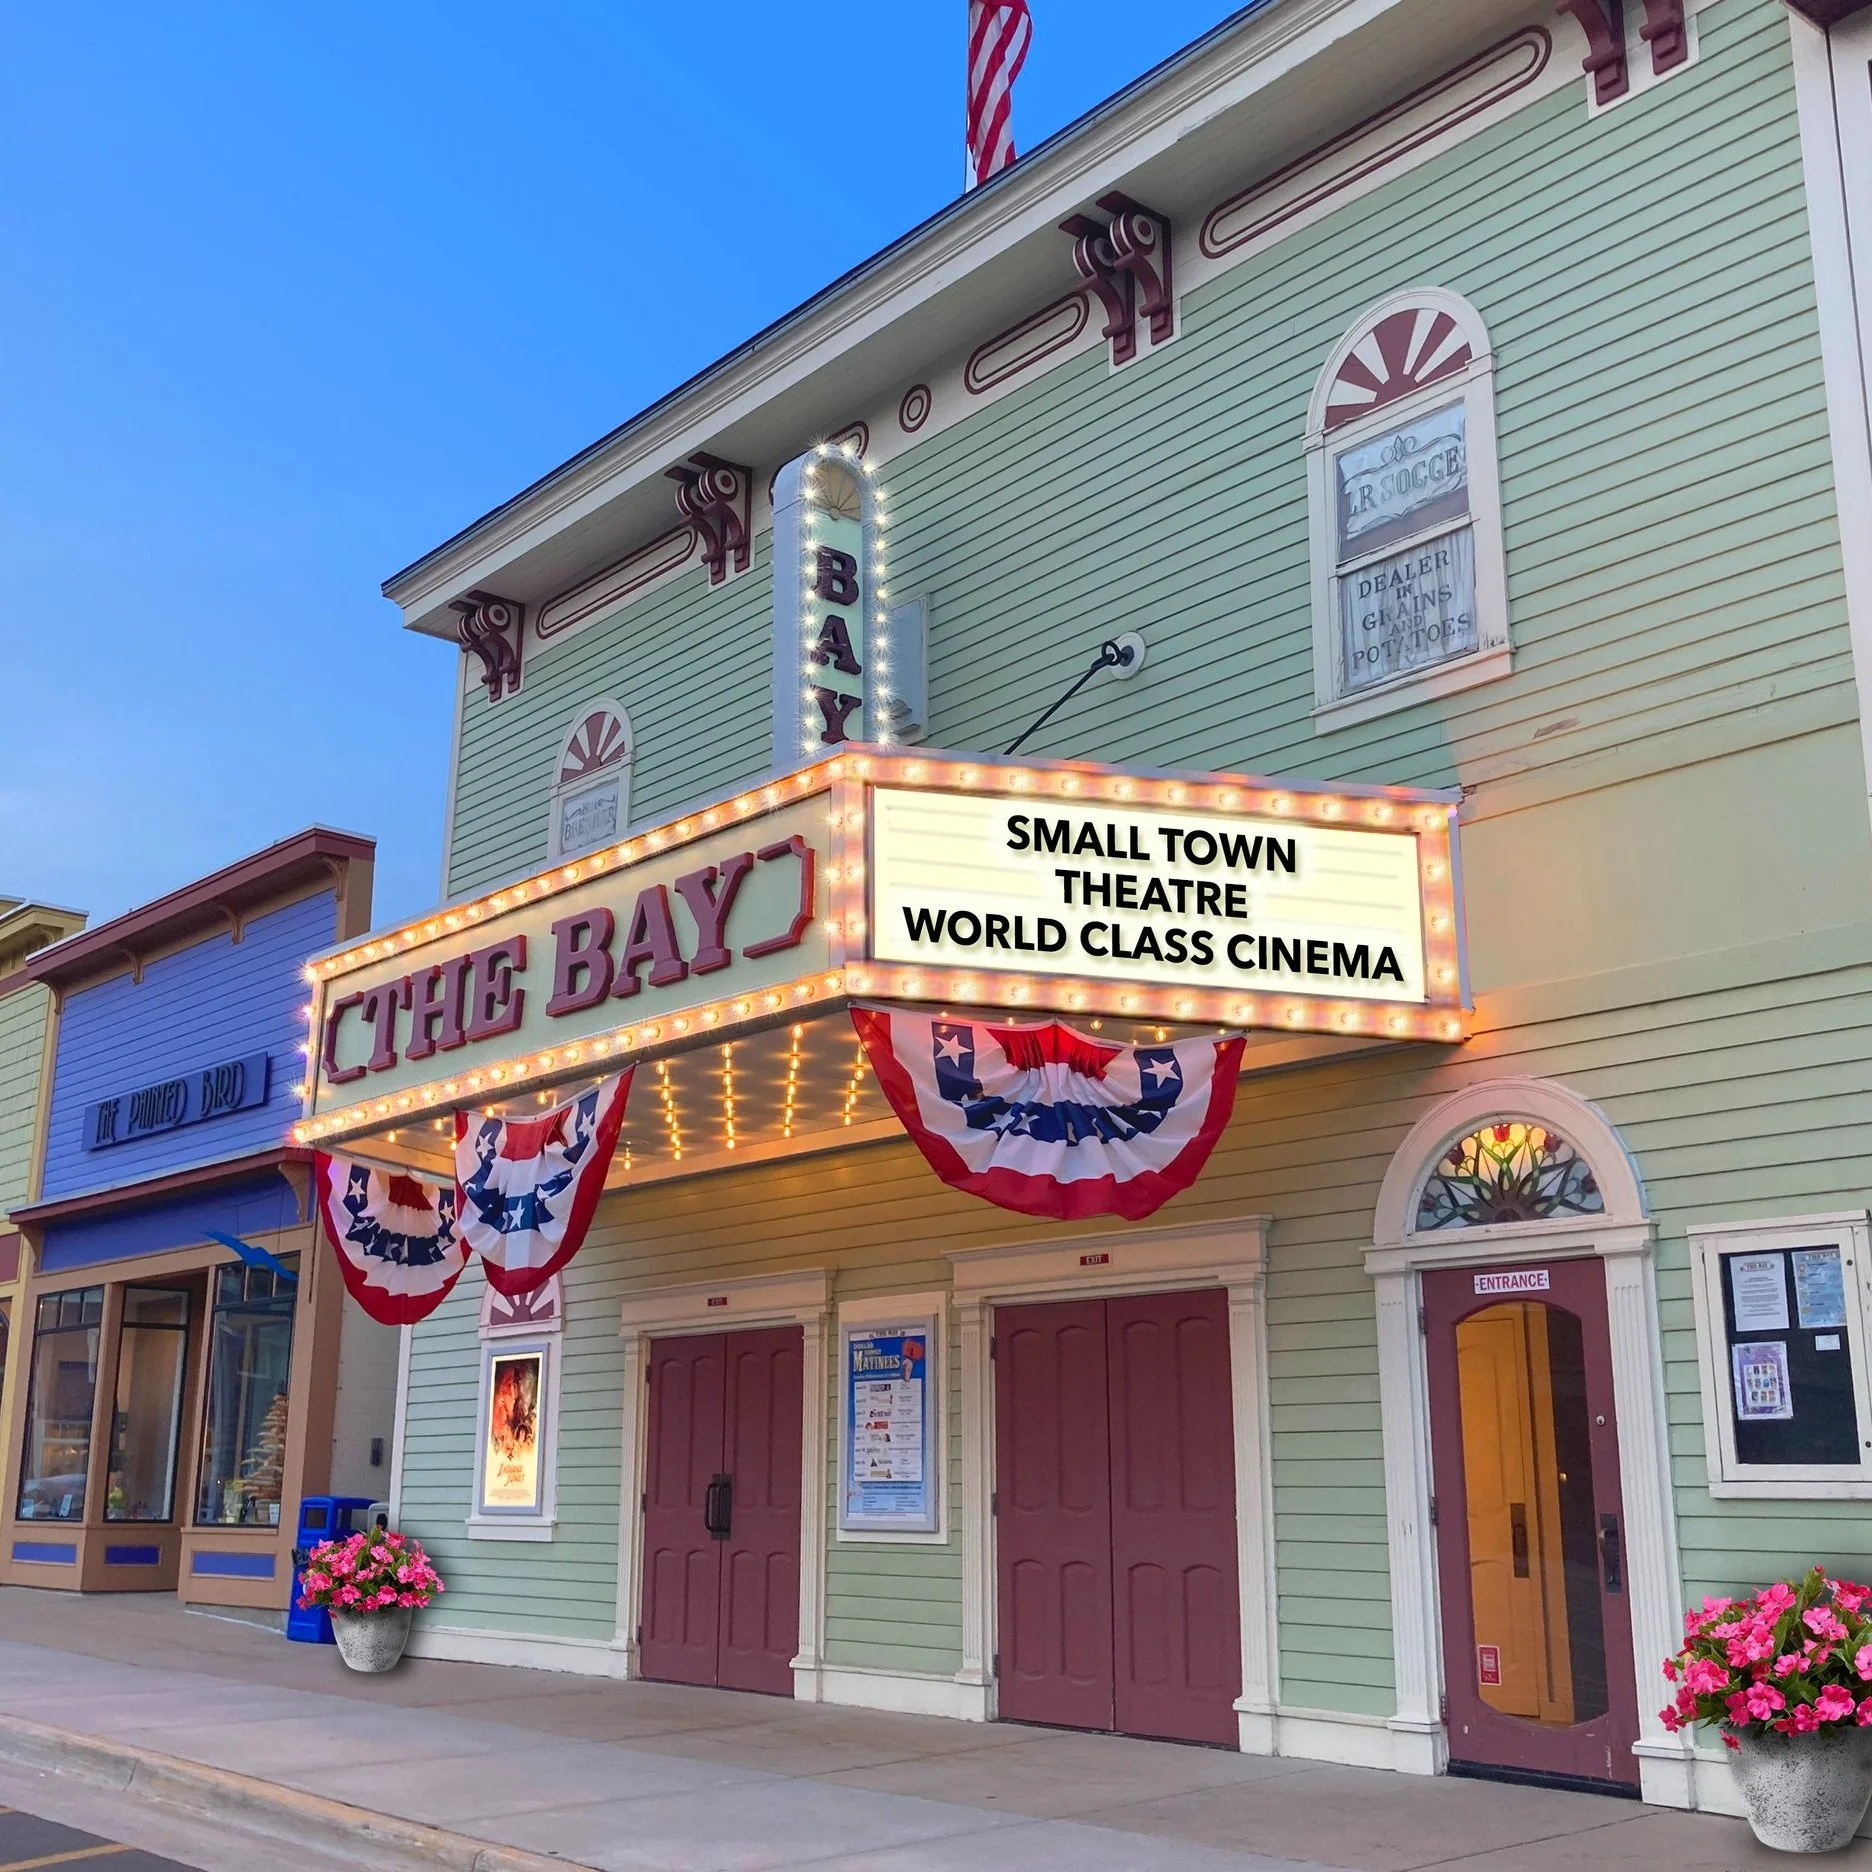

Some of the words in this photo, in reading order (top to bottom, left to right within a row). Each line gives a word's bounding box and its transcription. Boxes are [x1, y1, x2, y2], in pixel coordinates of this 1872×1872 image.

[1359, 550, 1450, 599] DEALER
[1396, 583, 1412, 600] IN
[1362, 584, 1453, 631] GRAINS
[1389, 615, 1422, 636] AND
[809, 545, 863, 745] BAY
[1006, 814, 1150, 861] SMALL
[1158, 827, 1297, 873] TOWN
[1055, 869, 1248, 918] THEATRE
[361, 934, 526, 1071] THE
[546, 852, 754, 1017] BAY
[902, 906, 1067, 953] WORLD
[1080, 920, 1214, 966] CLASS
[1227, 934, 1405, 982] CINEMA
[96, 1098, 120, 1144] THE
[128, 1079, 187, 1135] PAINTED
[201, 1061, 245, 1117] BIRD
[1086, 1256, 1103, 1265] EXIT
[1480, 1273, 1545, 1290] ENTRANCE
